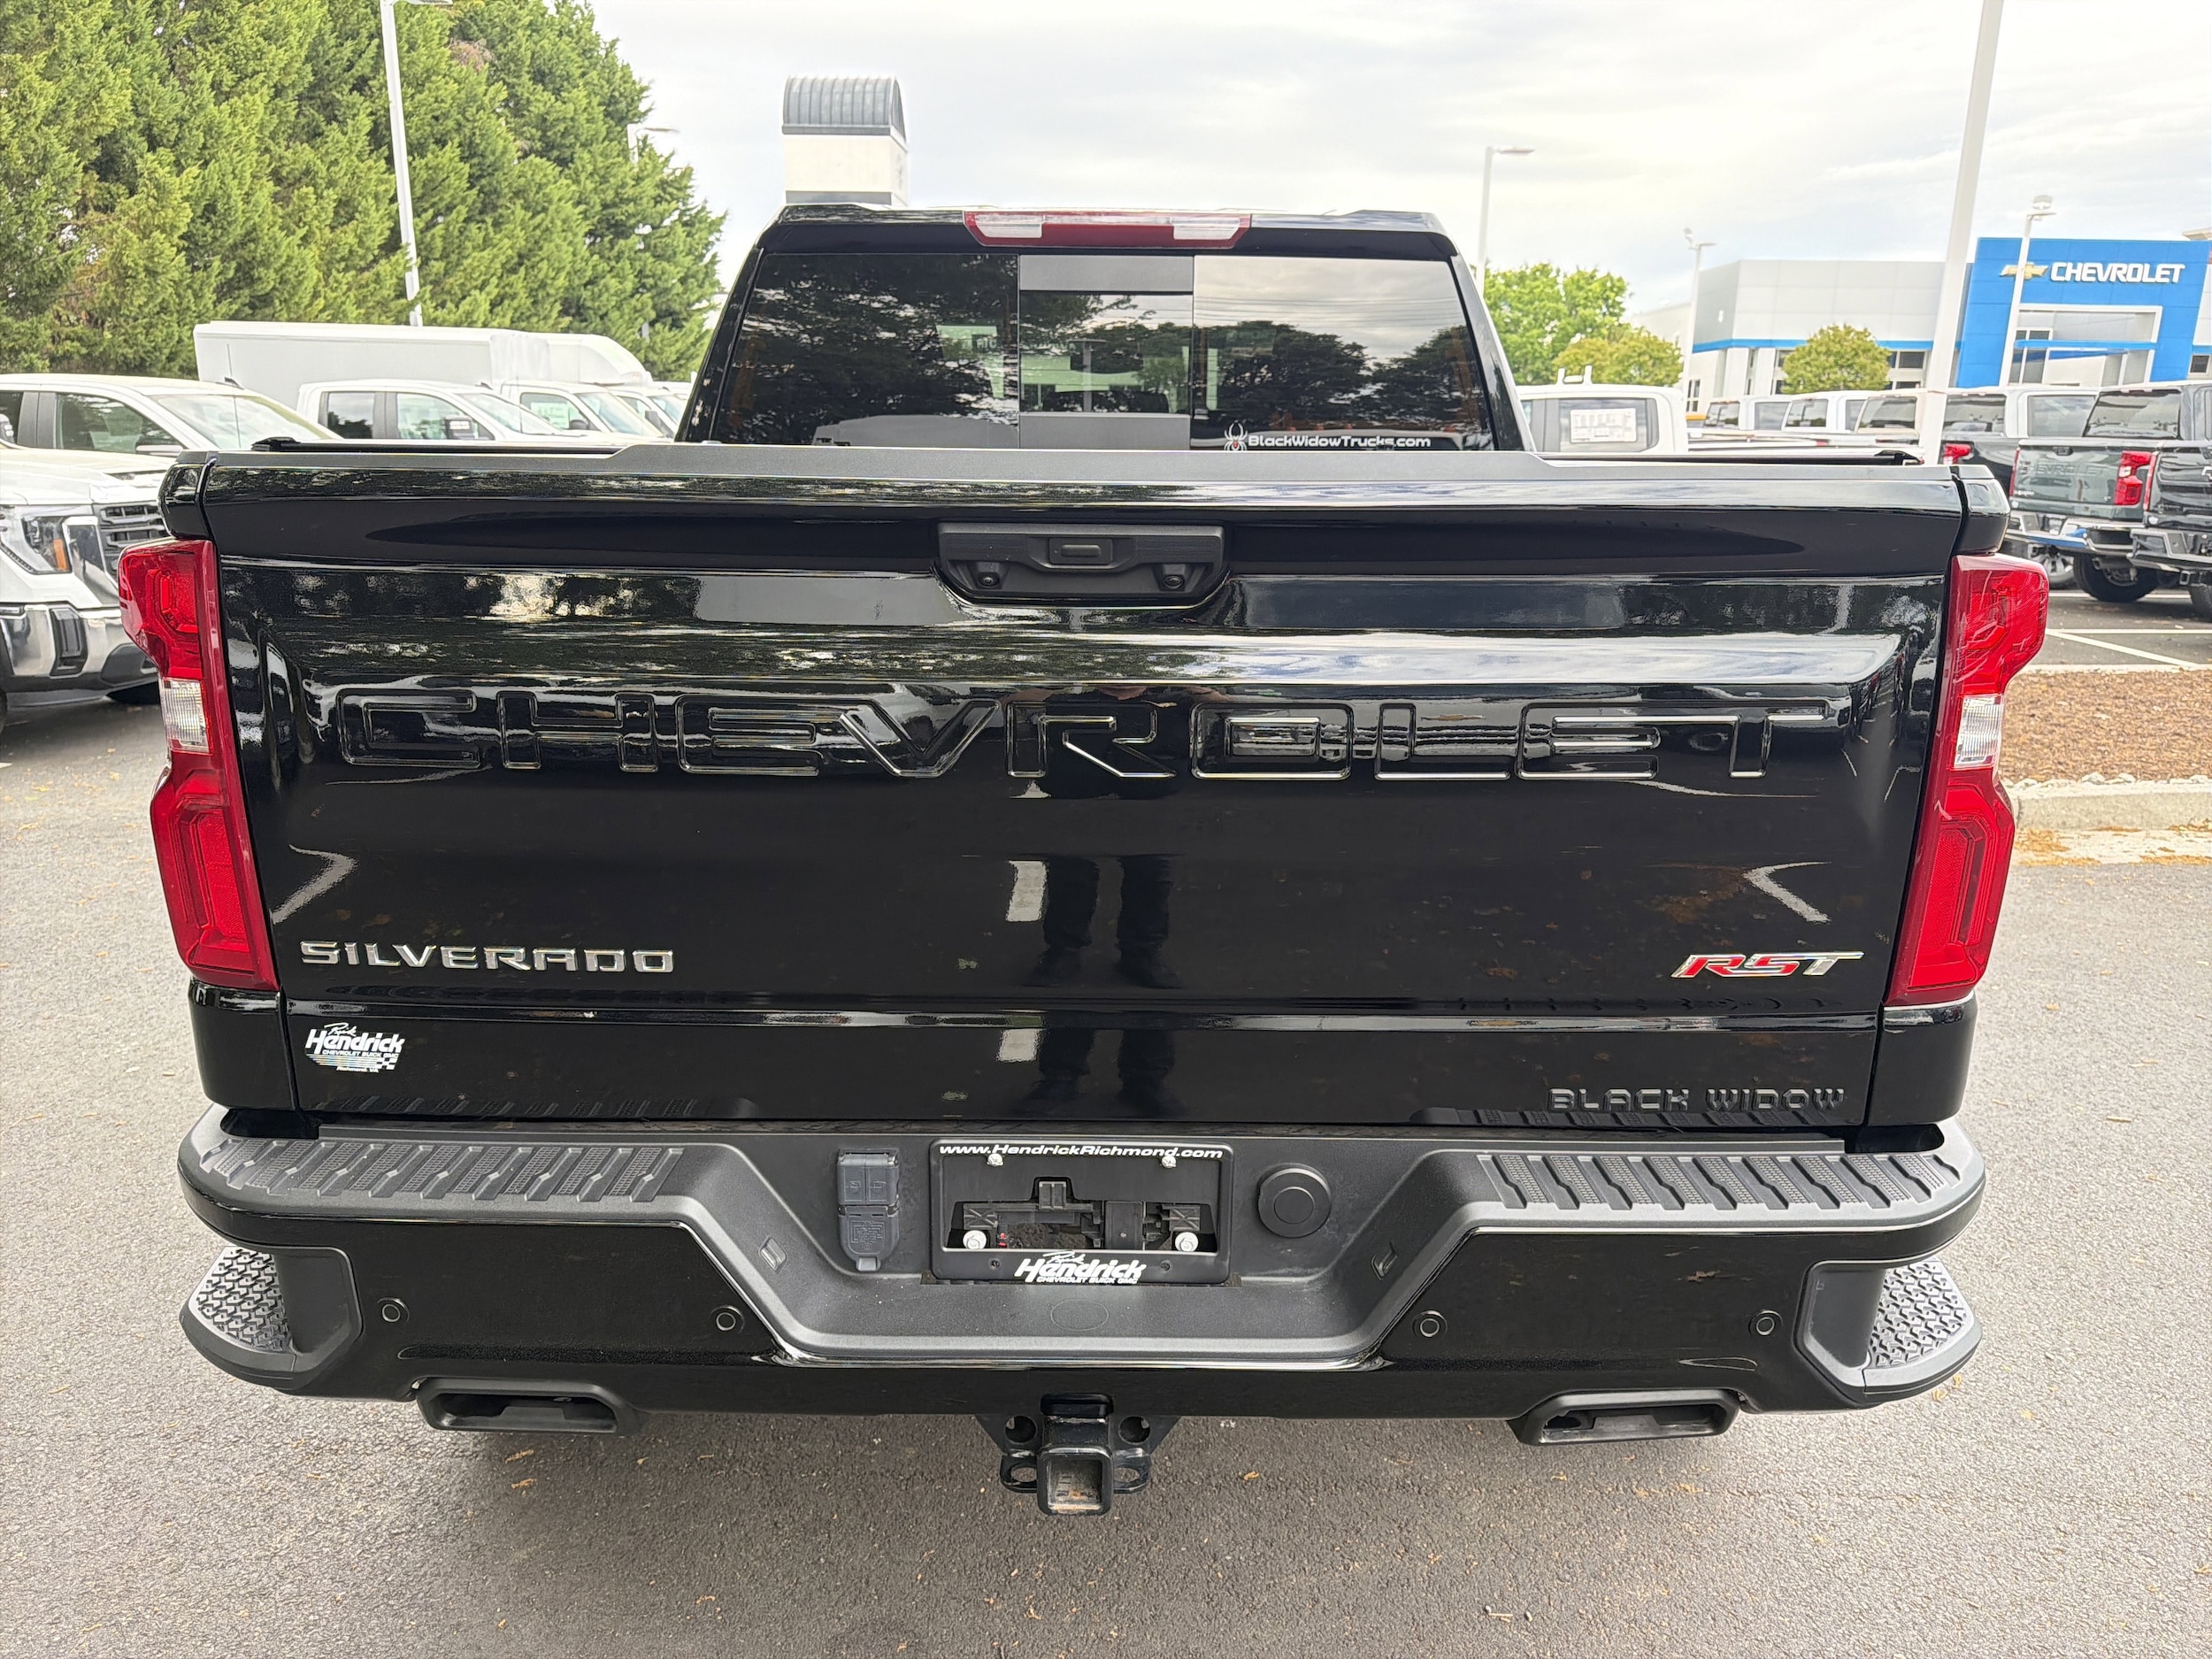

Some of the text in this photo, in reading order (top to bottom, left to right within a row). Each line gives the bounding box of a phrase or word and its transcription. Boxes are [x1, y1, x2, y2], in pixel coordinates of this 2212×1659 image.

[2050, 262, 2186, 283] CHEVROLET
[1248, 434, 1431, 448] BlackWidowTrucks.com
[335, 688, 1836, 780] CHEVROLET
[300, 941, 674, 973] SILVERADO
[1671, 951, 1864, 978] RST
[305, 1029, 405, 1054] Hendrick
[1548, 1087, 1844, 1111] BLACK WIDOW
[940, 1144, 1224, 1158] www.HendrickRichmond.com
[1014, 1258, 1147, 1282] Hendrick
